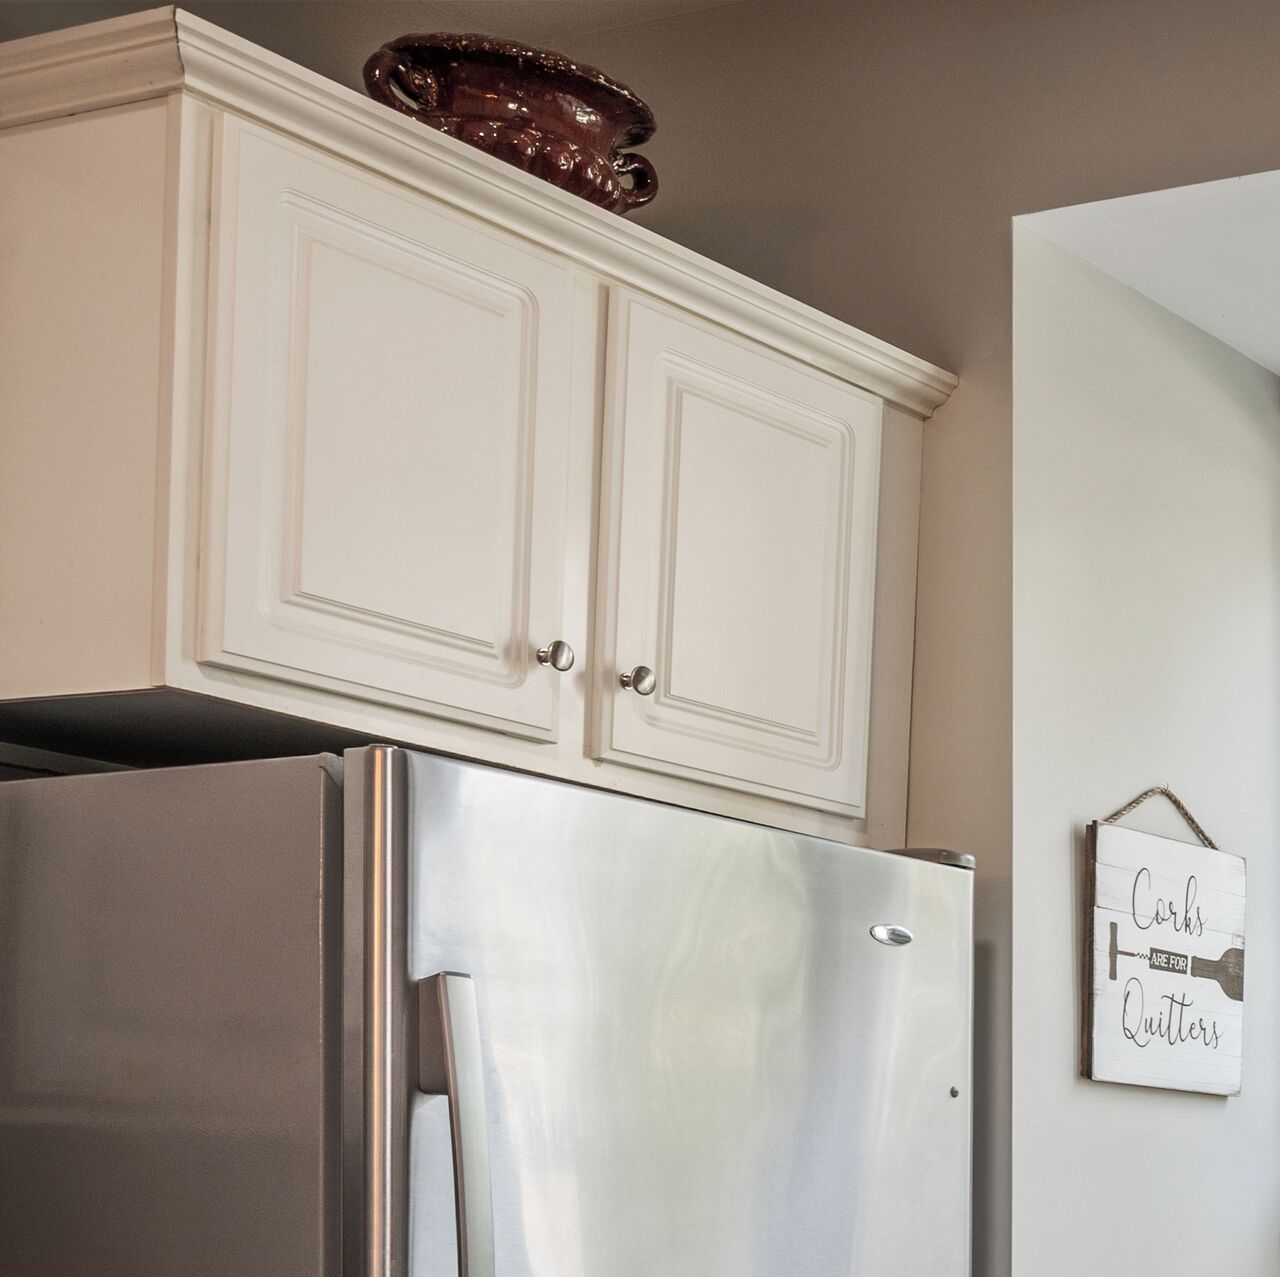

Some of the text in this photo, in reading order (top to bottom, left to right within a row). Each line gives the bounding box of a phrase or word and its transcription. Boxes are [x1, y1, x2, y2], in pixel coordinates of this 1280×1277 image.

[1132, 867, 1208, 937] Corks
[1151, 952, 1187, 970] ARE FOR
[1122, 977, 1224, 1049] Quitters
